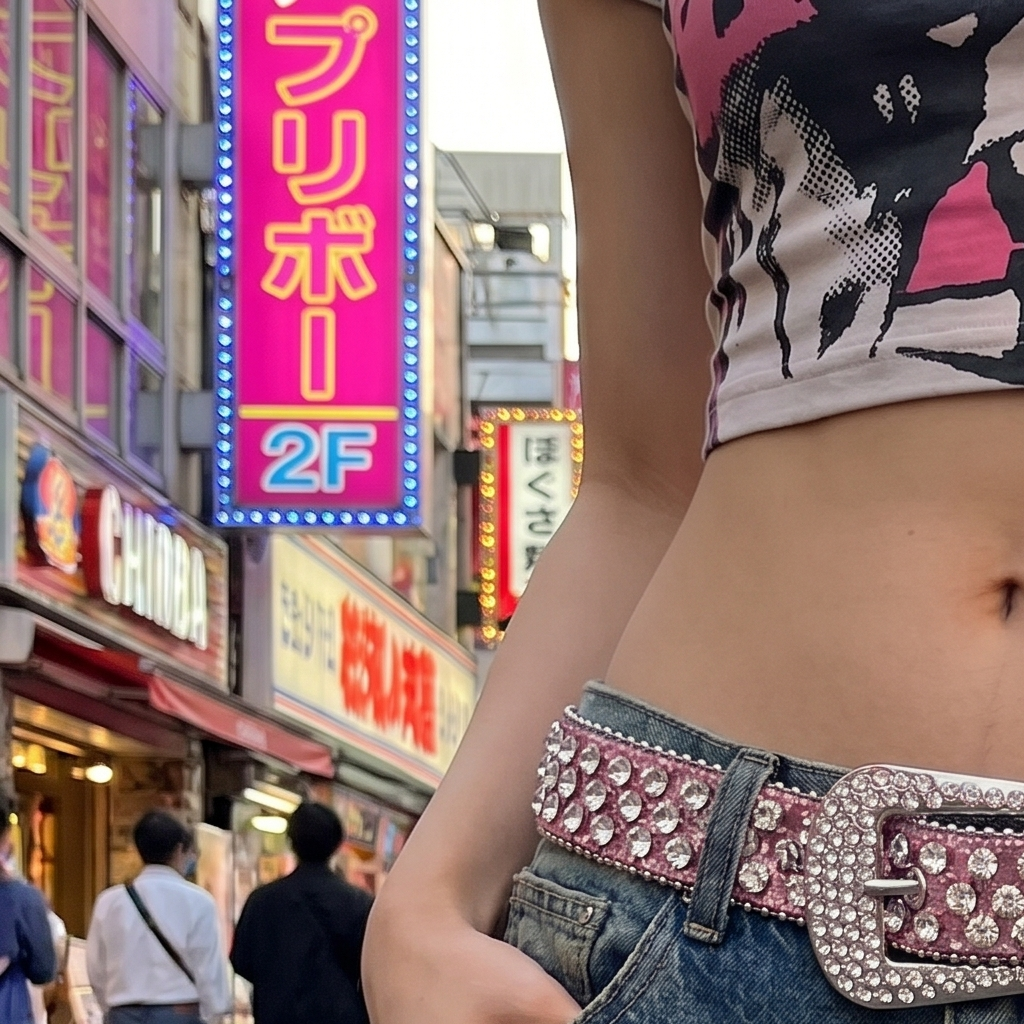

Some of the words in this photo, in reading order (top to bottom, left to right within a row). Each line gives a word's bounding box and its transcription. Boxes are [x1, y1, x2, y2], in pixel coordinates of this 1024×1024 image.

[261, 5, 378, 402] プリボー
[262, 423, 376, 494] 2F
